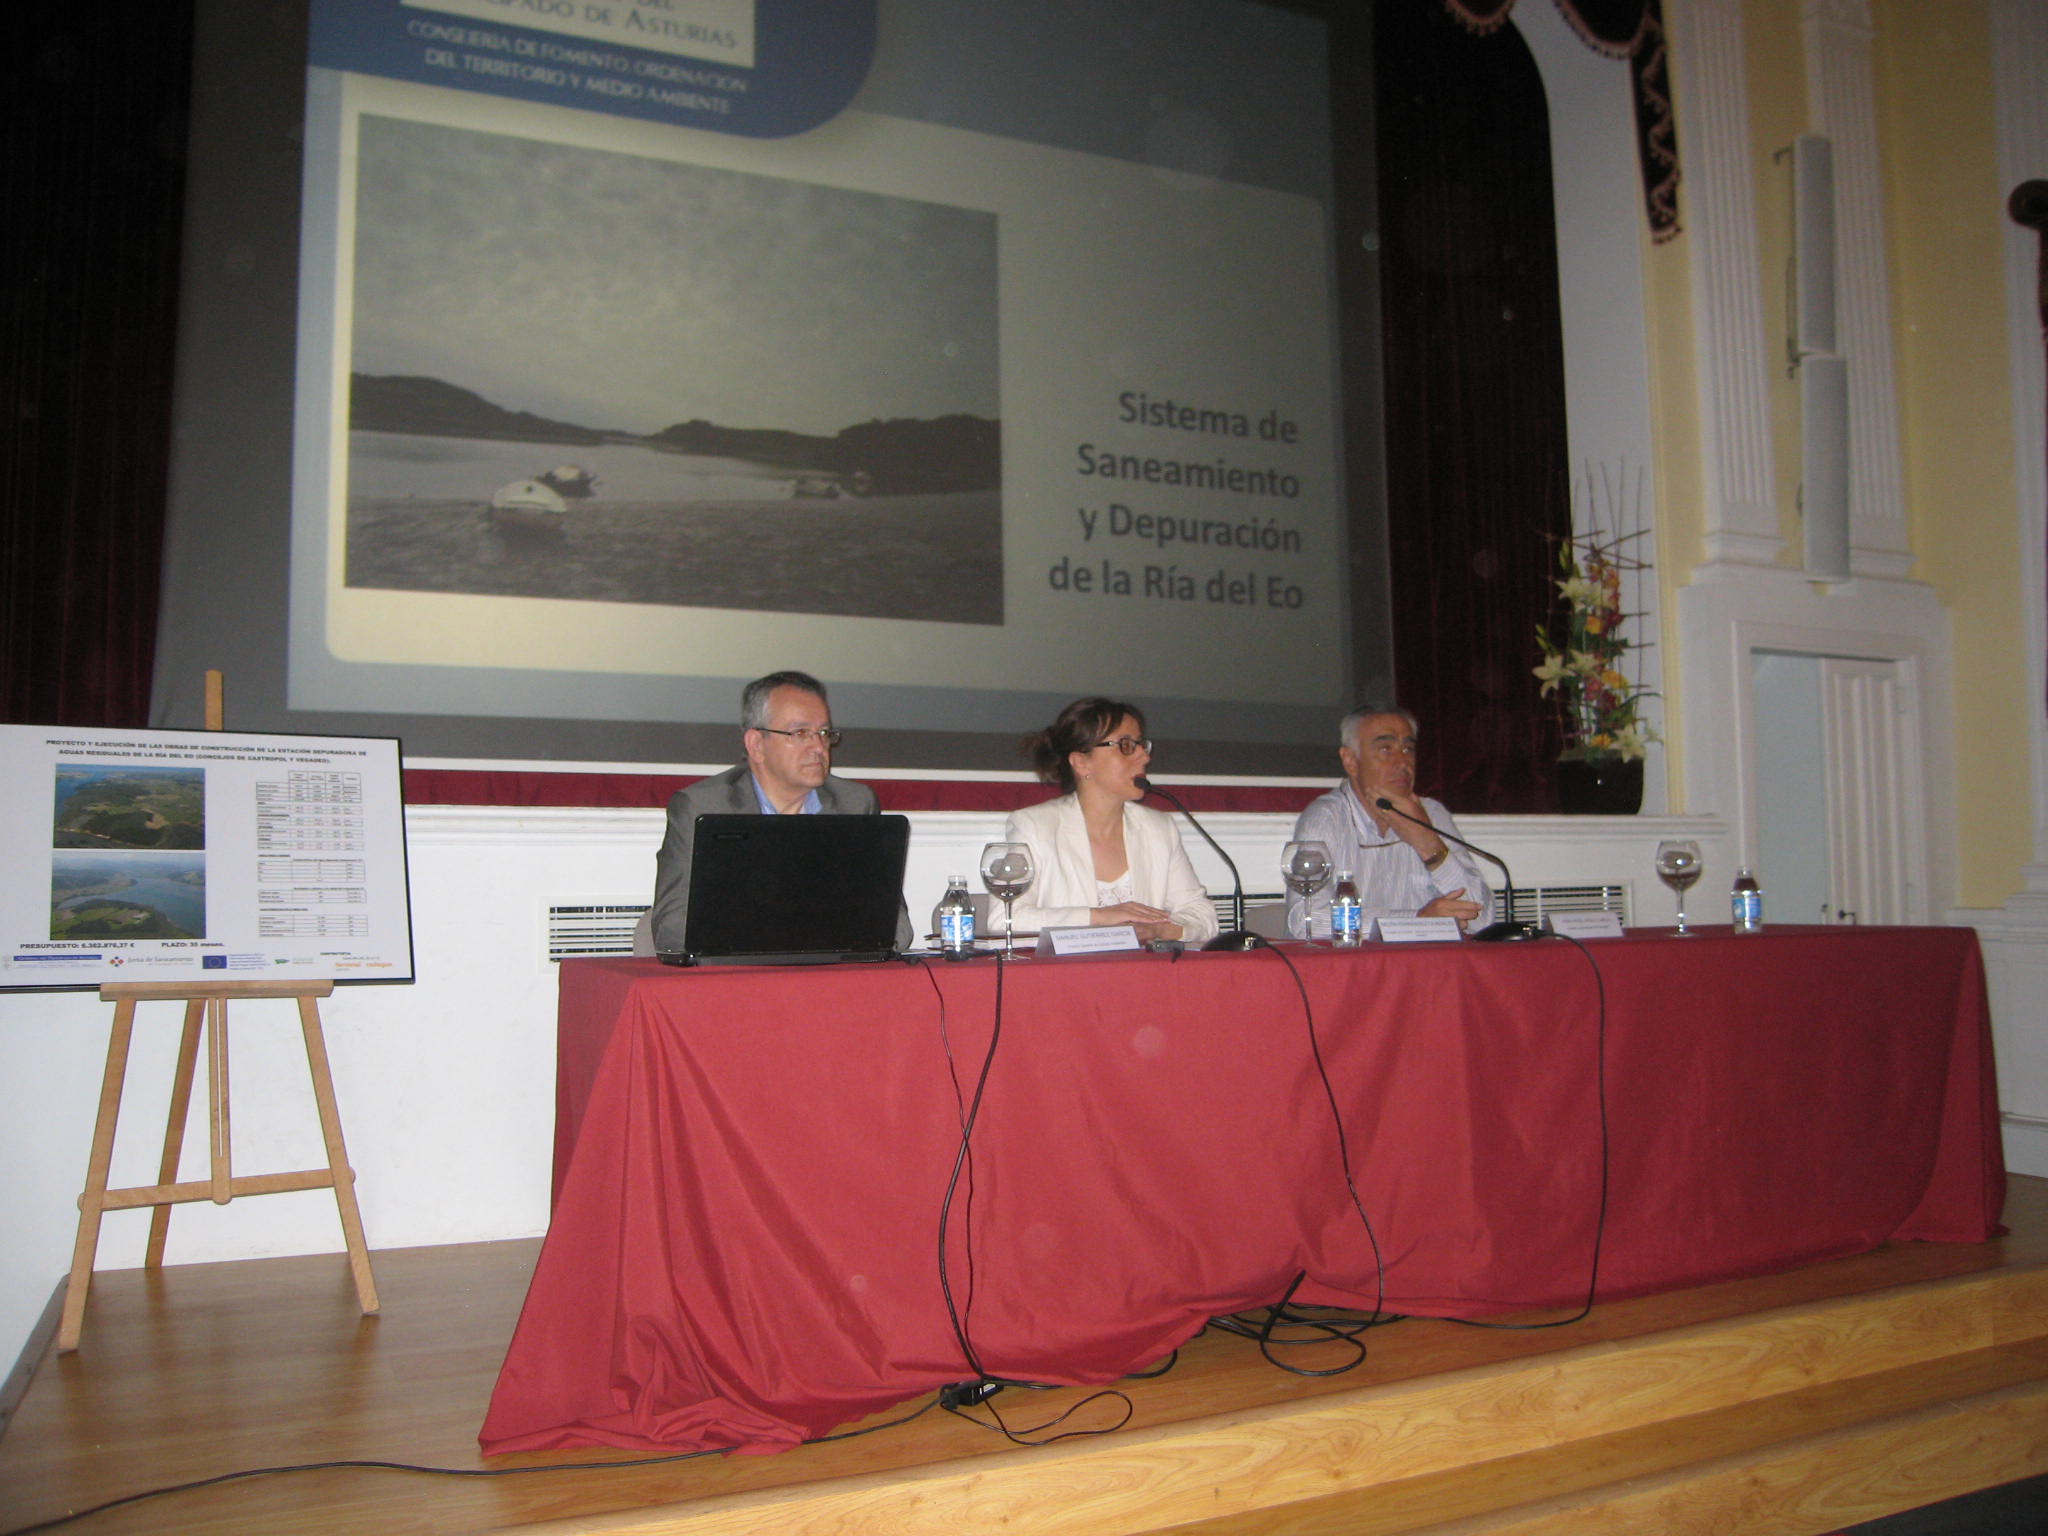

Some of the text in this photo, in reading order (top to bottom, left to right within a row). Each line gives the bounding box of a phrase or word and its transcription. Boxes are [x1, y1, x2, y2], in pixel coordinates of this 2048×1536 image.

[585, 5, 612, 26] DE
[514, 38, 537, 57] DE
[424, 48, 731, 115] DEL TERRITORIO Y MEDIO AMBIENTE
[1118, 391, 1298, 443] Sistema de
[1077, 442, 1300, 499] Saneamiento
[1078, 503, 1300, 553] y Depuración
[1049, 556, 1304, 610] de la Ría del Eo
[46, 739, 86, 747] PROYECTO
